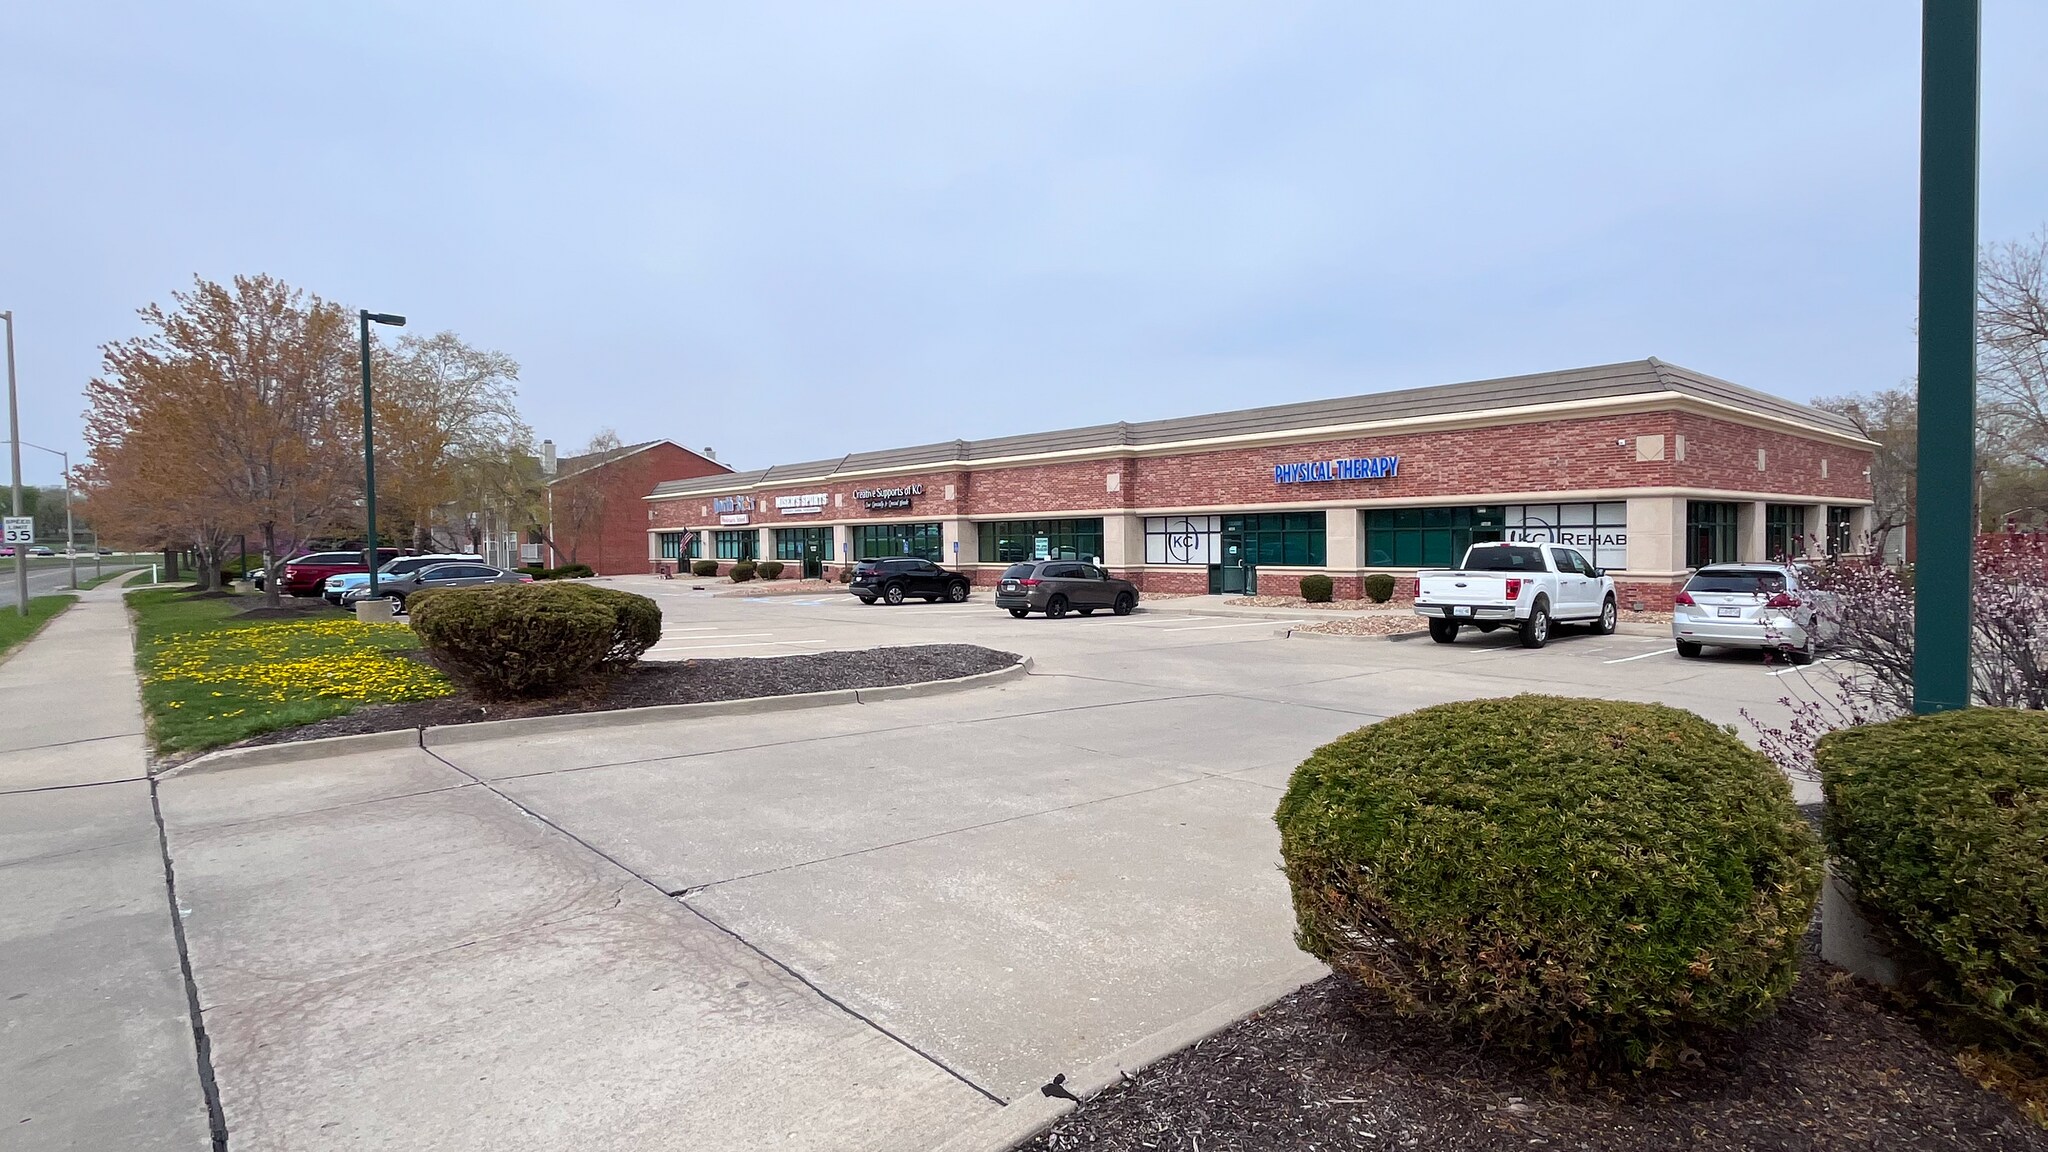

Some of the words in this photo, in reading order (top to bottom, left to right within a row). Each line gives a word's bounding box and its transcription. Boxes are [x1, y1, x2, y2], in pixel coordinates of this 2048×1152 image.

[1274, 461, 1333, 483] PHYSICAL
[1336, 456, 1399, 480] THERAPY
[876, 486, 904, 498] Supports
[904, 485, 912, 495] of
[912, 484, 923, 495] KC
[6, 530, 31, 541] 35
[1173, 536, 1193, 548] KC
[1561, 533, 1627, 546] REHAB
